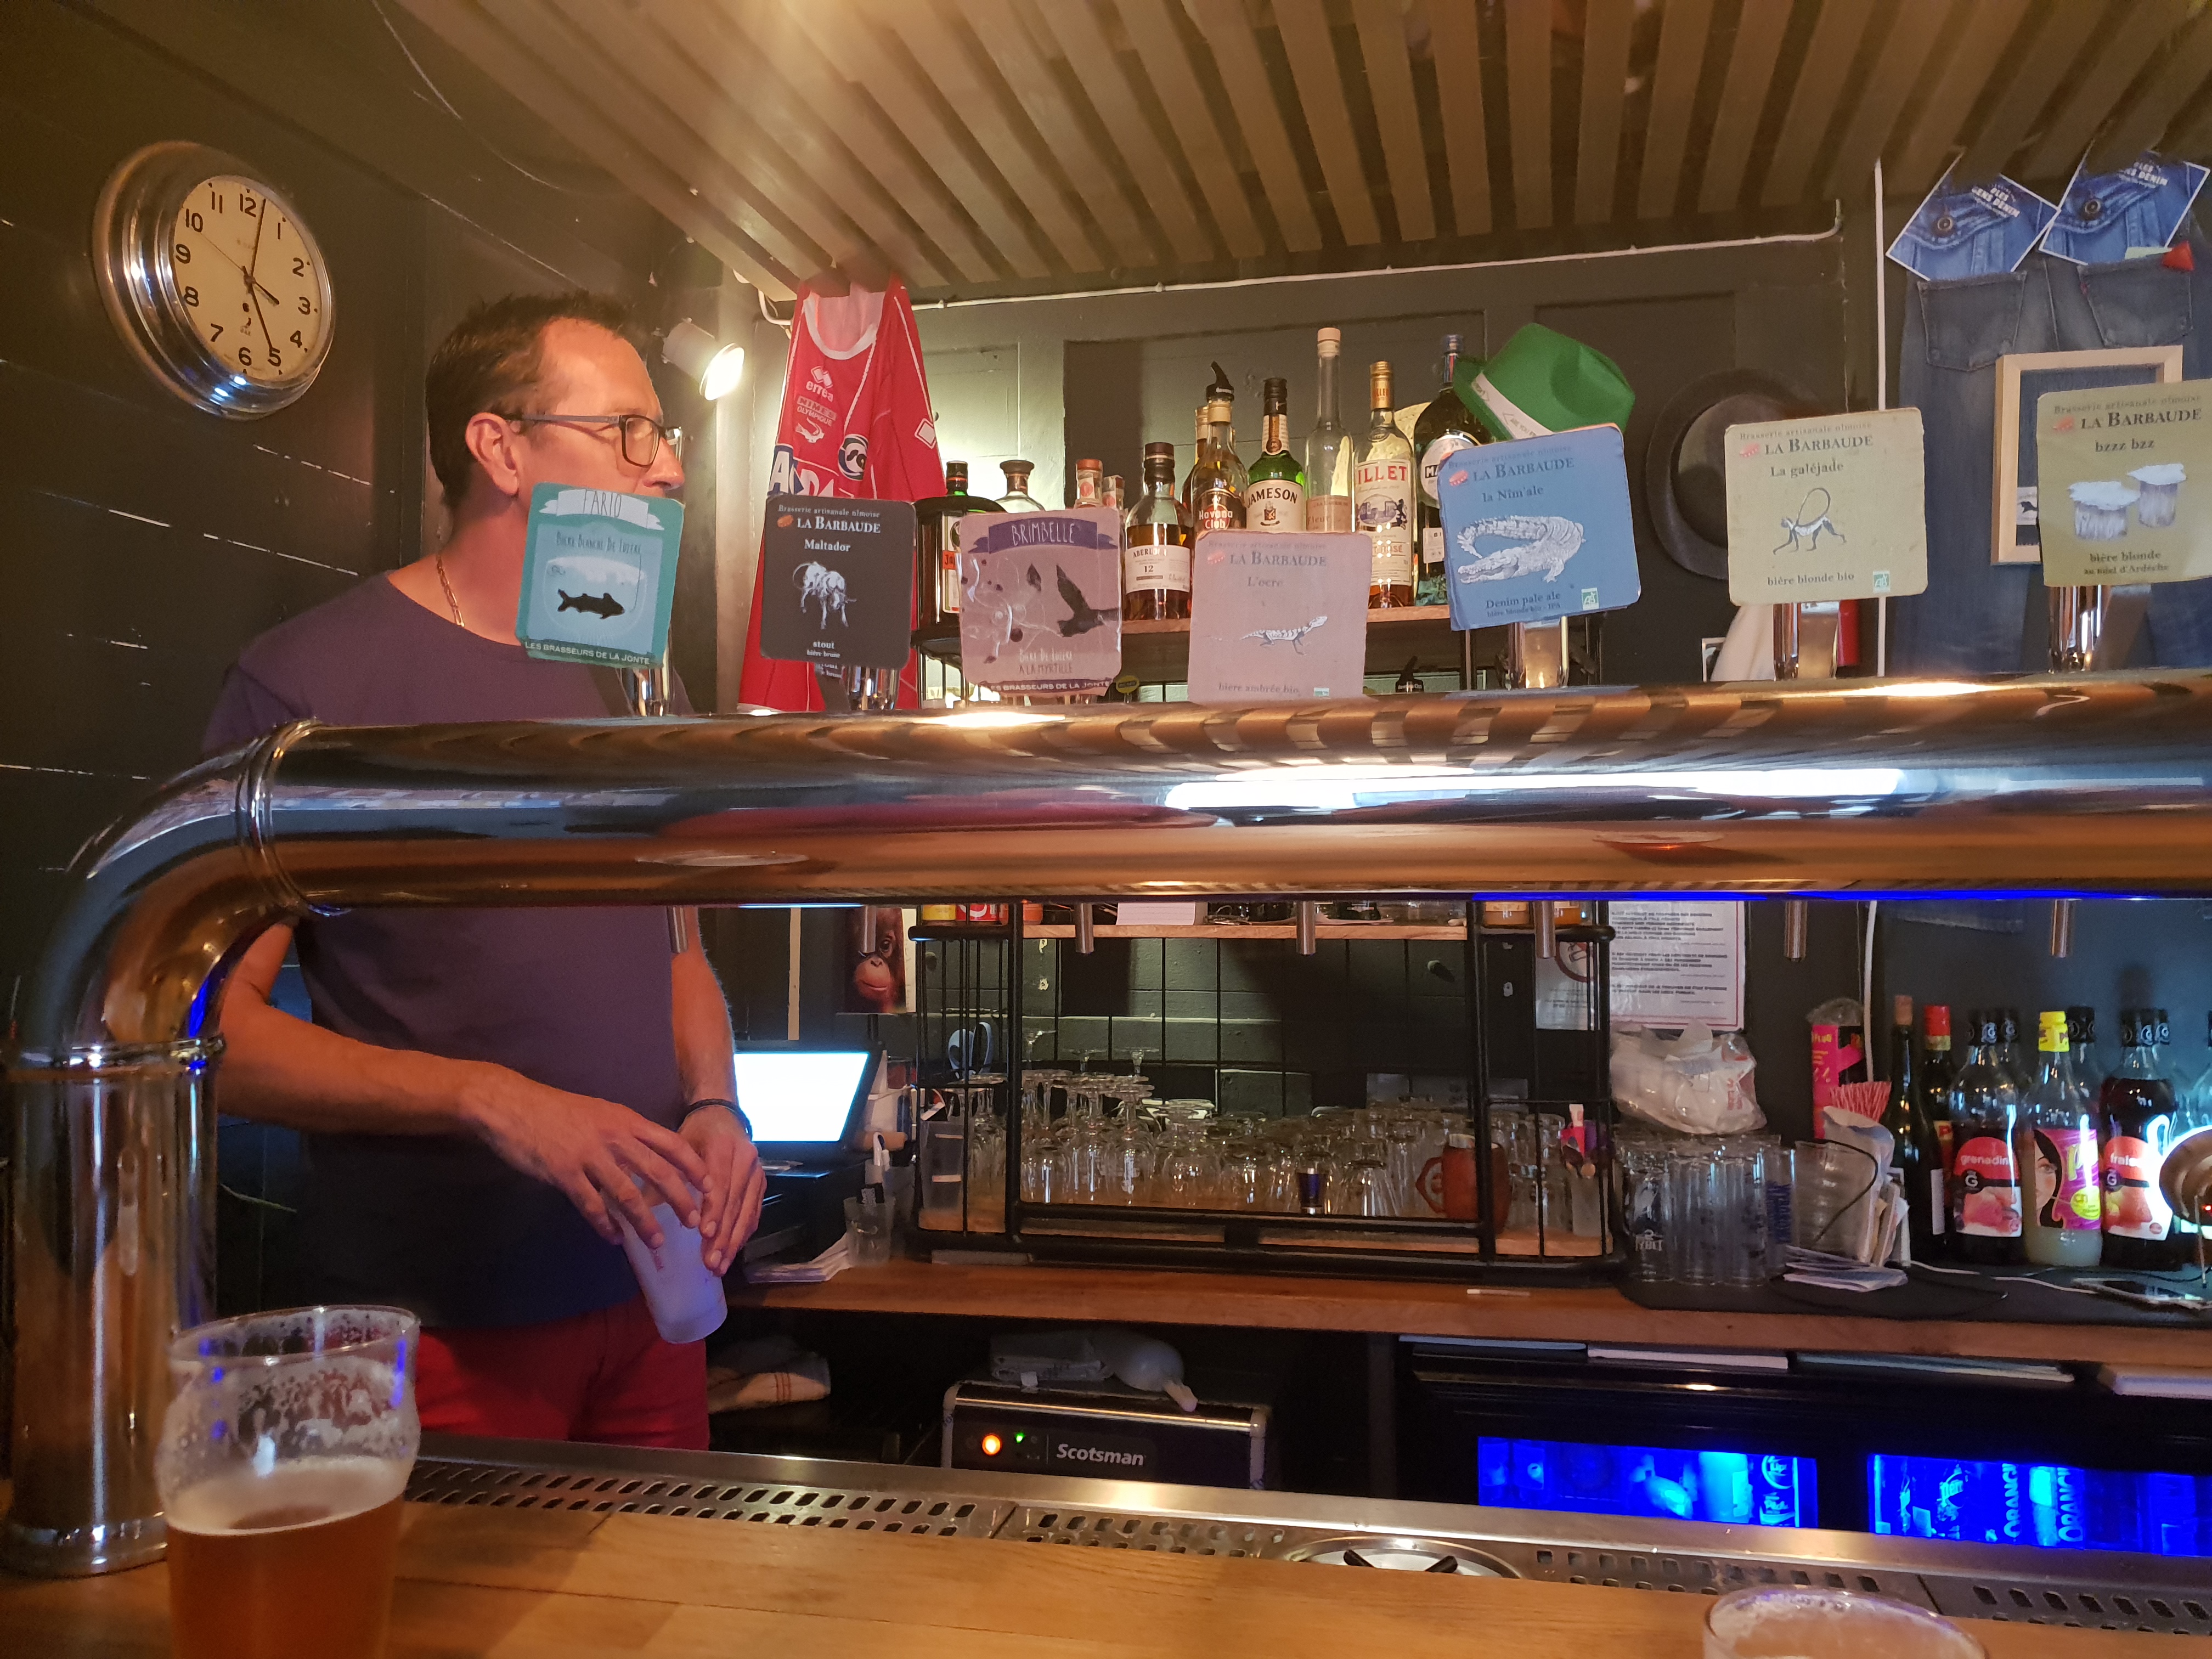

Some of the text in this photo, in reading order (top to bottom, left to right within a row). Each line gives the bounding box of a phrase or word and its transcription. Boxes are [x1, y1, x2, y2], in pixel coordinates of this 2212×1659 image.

[211, 191, 223, 214] 11
[240, 193, 257, 218] 12
[185, 208, 204, 233] 10
[277, 222, 282, 240] 1
[175, 243, 191, 264] 9
[292, 257, 304, 277] 2
[184, 286, 200, 307] 8
[298, 296, 311, 315] 3
[210, 323, 224, 342] 7
[290, 330, 303, 348] 4
[239, 347, 252, 366] 6
[268, 348, 281, 367] 5
[2107, 408, 2202, 428] BARBAUDE
[1788, 434, 1874, 453] BARBAUDE
[2095, 437, 2155, 453] bzzz bzz
[1494, 457, 1575, 479] BARBAUDE
[1770, 456, 1844, 479] La galéjade
[1247, 487, 1298, 509] JAMESON
[1481, 493, 1493, 503] la
[778, 504, 812, 514] Brasserie
[1199, 510, 1233, 520] Havana
[815, 516, 882, 534] BARBAUDE
[1204, 518, 1227, 530] Club
[1011, 522, 1075, 546] BRIMBELLE
[804, 538, 851, 552] Maltador
[1251, 550, 1327, 567] BARBAUDE
[2121, 549, 2162, 561] blonde
[1767, 571, 1855, 586] bière blonde bio
[1486, 590, 1561, 609] Denim pale ale
[524, 641, 651, 665] LES BRASSEURS DE LA JONTE
[812, 640, 835, 650] stout
[823, 650, 841, 658] brune
[1038, 663, 1073, 674] MYRTILLE
[1003, 683, 1054, 691] BRASSEURS
[1960, 1154, 2012, 1165] grenadin
[1056, 1443, 1144, 1467] Scotsman
